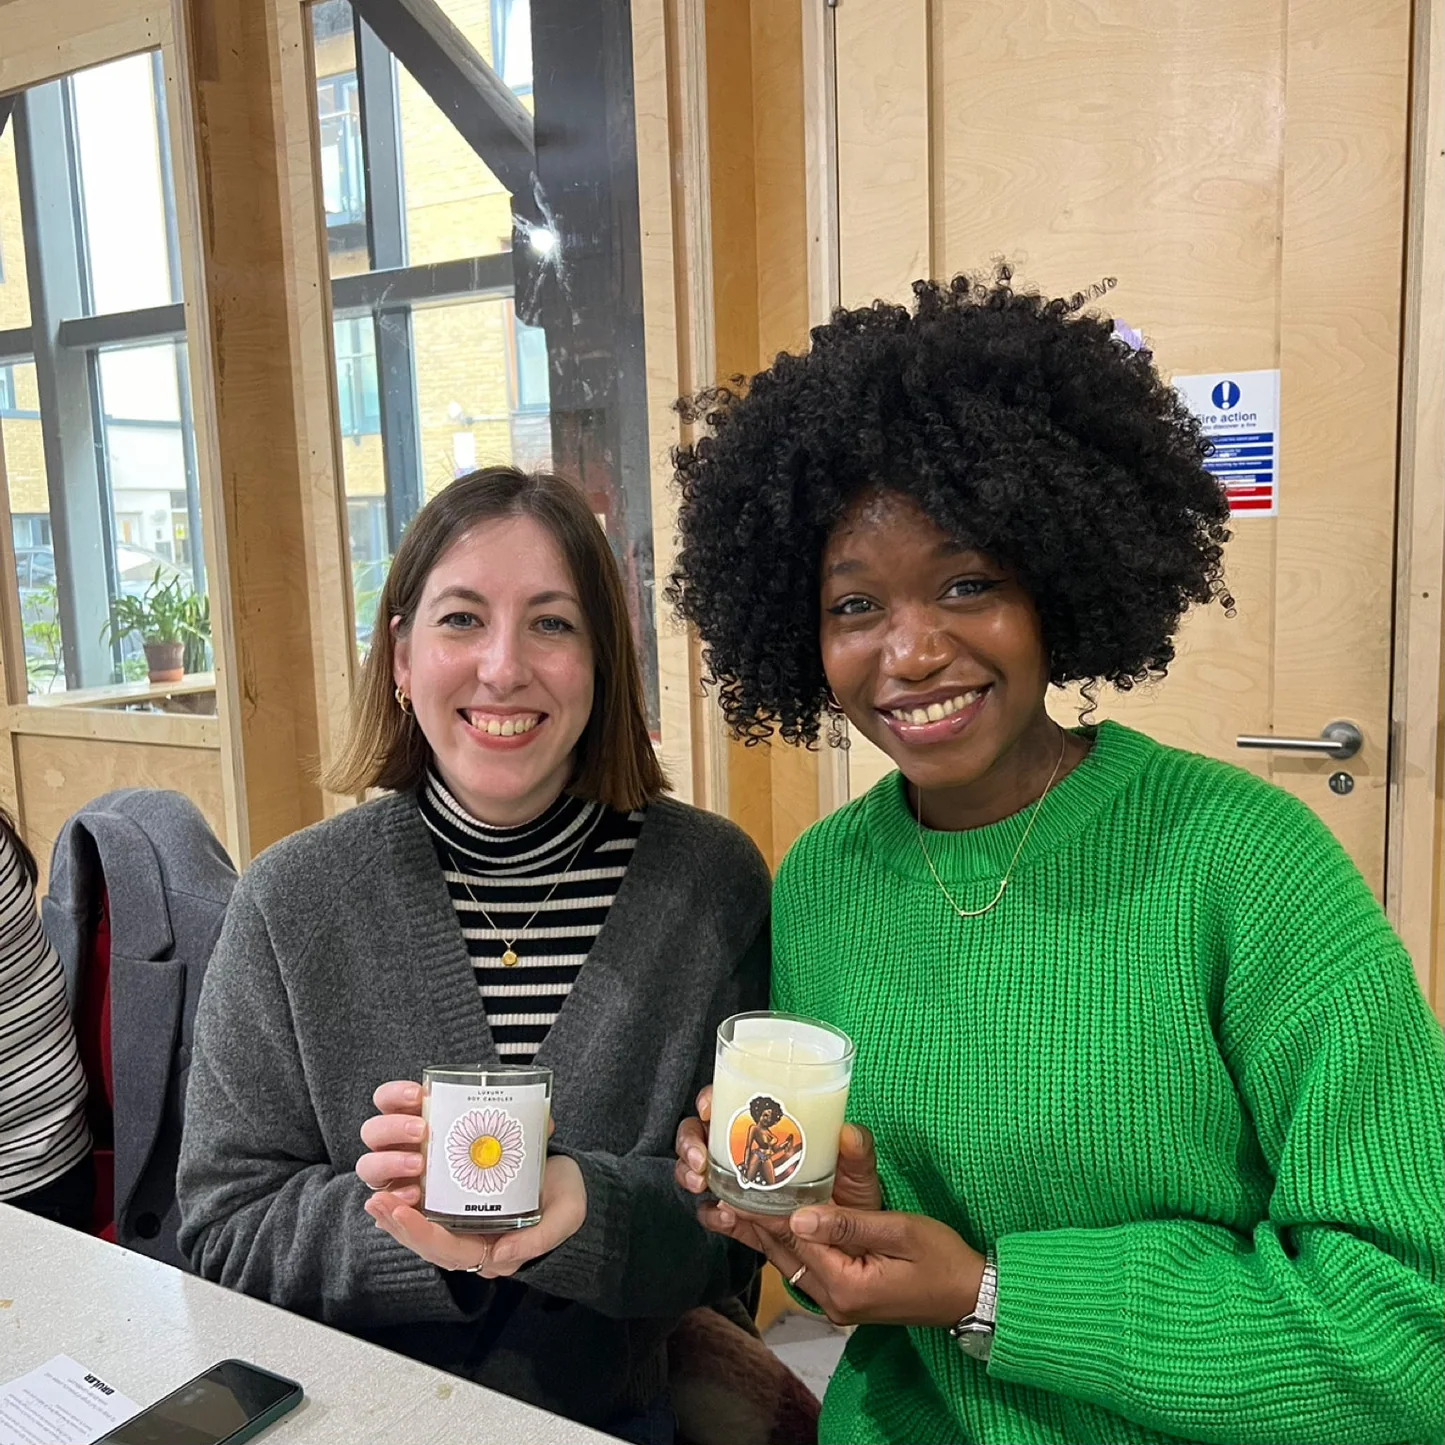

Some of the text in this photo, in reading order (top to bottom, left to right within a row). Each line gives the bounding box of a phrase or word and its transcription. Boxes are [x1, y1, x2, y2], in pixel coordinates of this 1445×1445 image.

[1196, 412, 1257, 424] Fire action
[464, 1204, 502, 1212] BRULER
[84, 1373, 115, 1396] BRULER
